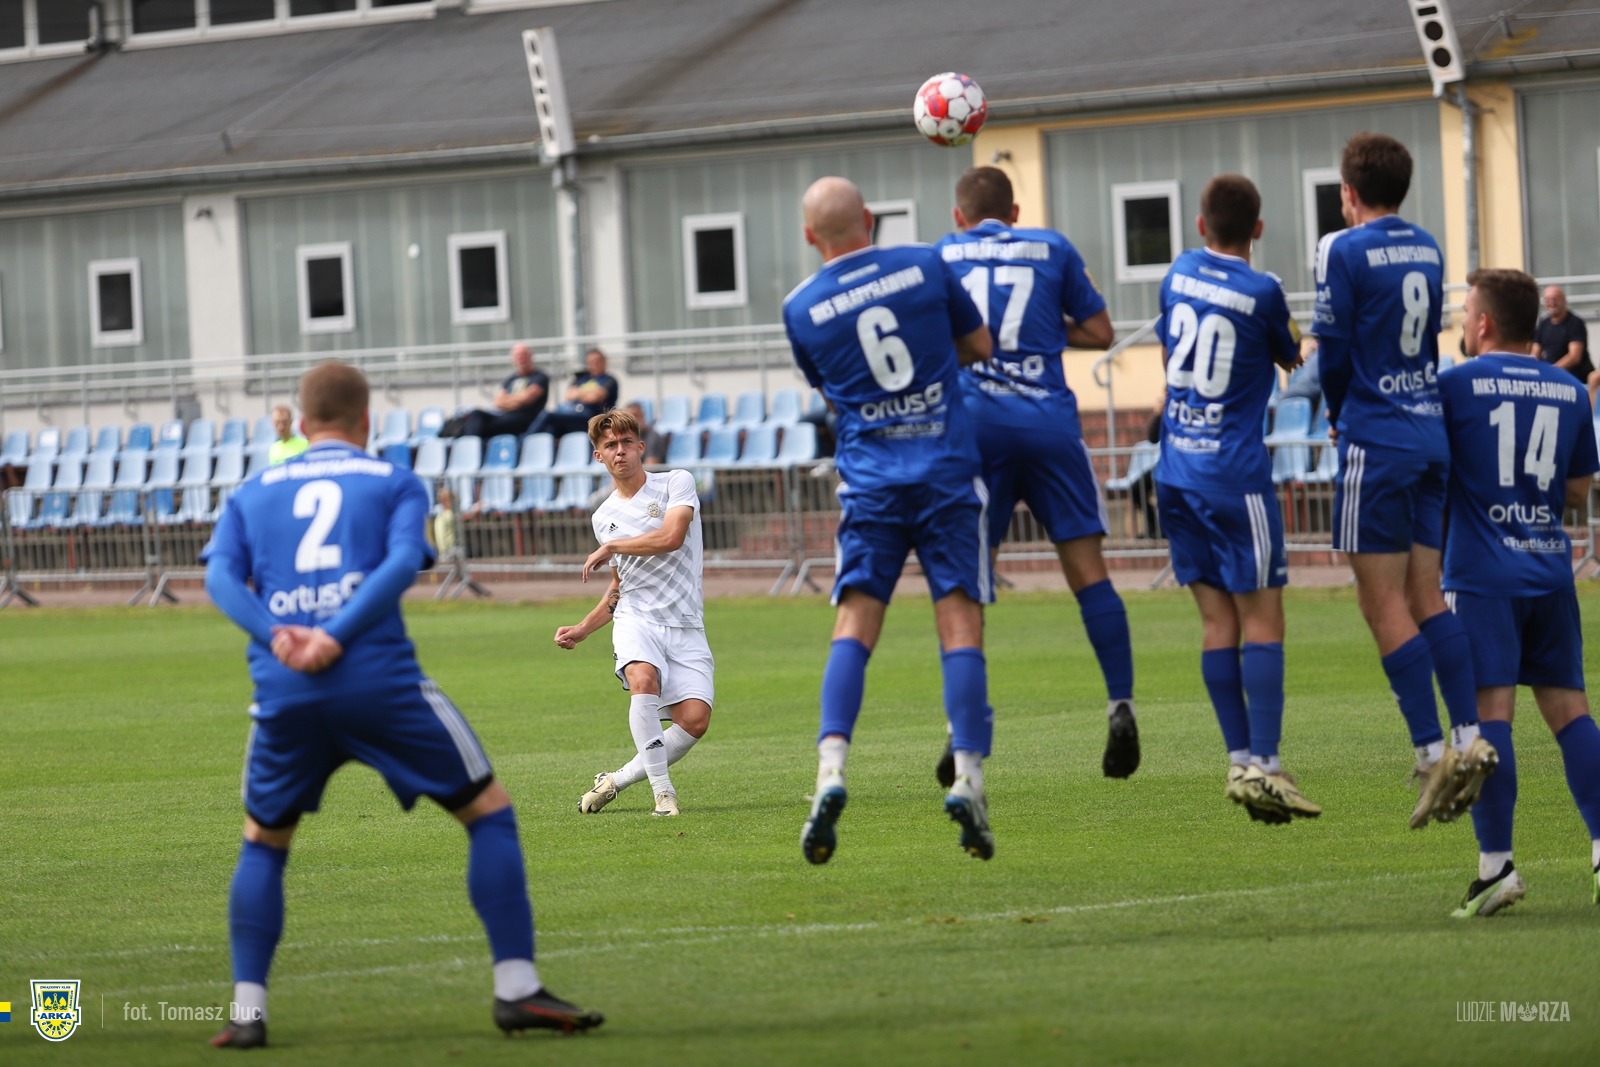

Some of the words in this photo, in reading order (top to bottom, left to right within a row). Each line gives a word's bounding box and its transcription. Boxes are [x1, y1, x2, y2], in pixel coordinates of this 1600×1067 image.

[856, 305, 914, 392] 6
[960, 266, 1034, 352] 17
[1167, 302, 1236, 398] 20
[1400, 271, 1429, 357] 8
[860, 393, 927, 422] ortus
[1472, 378, 1496, 396] MKS
[1496, 378, 1577, 403] WŁADYSŁAWOWO
[1489, 400, 1559, 492] 14
[293, 479, 343, 574] 2
[1488, 501, 1551, 524] ortus
